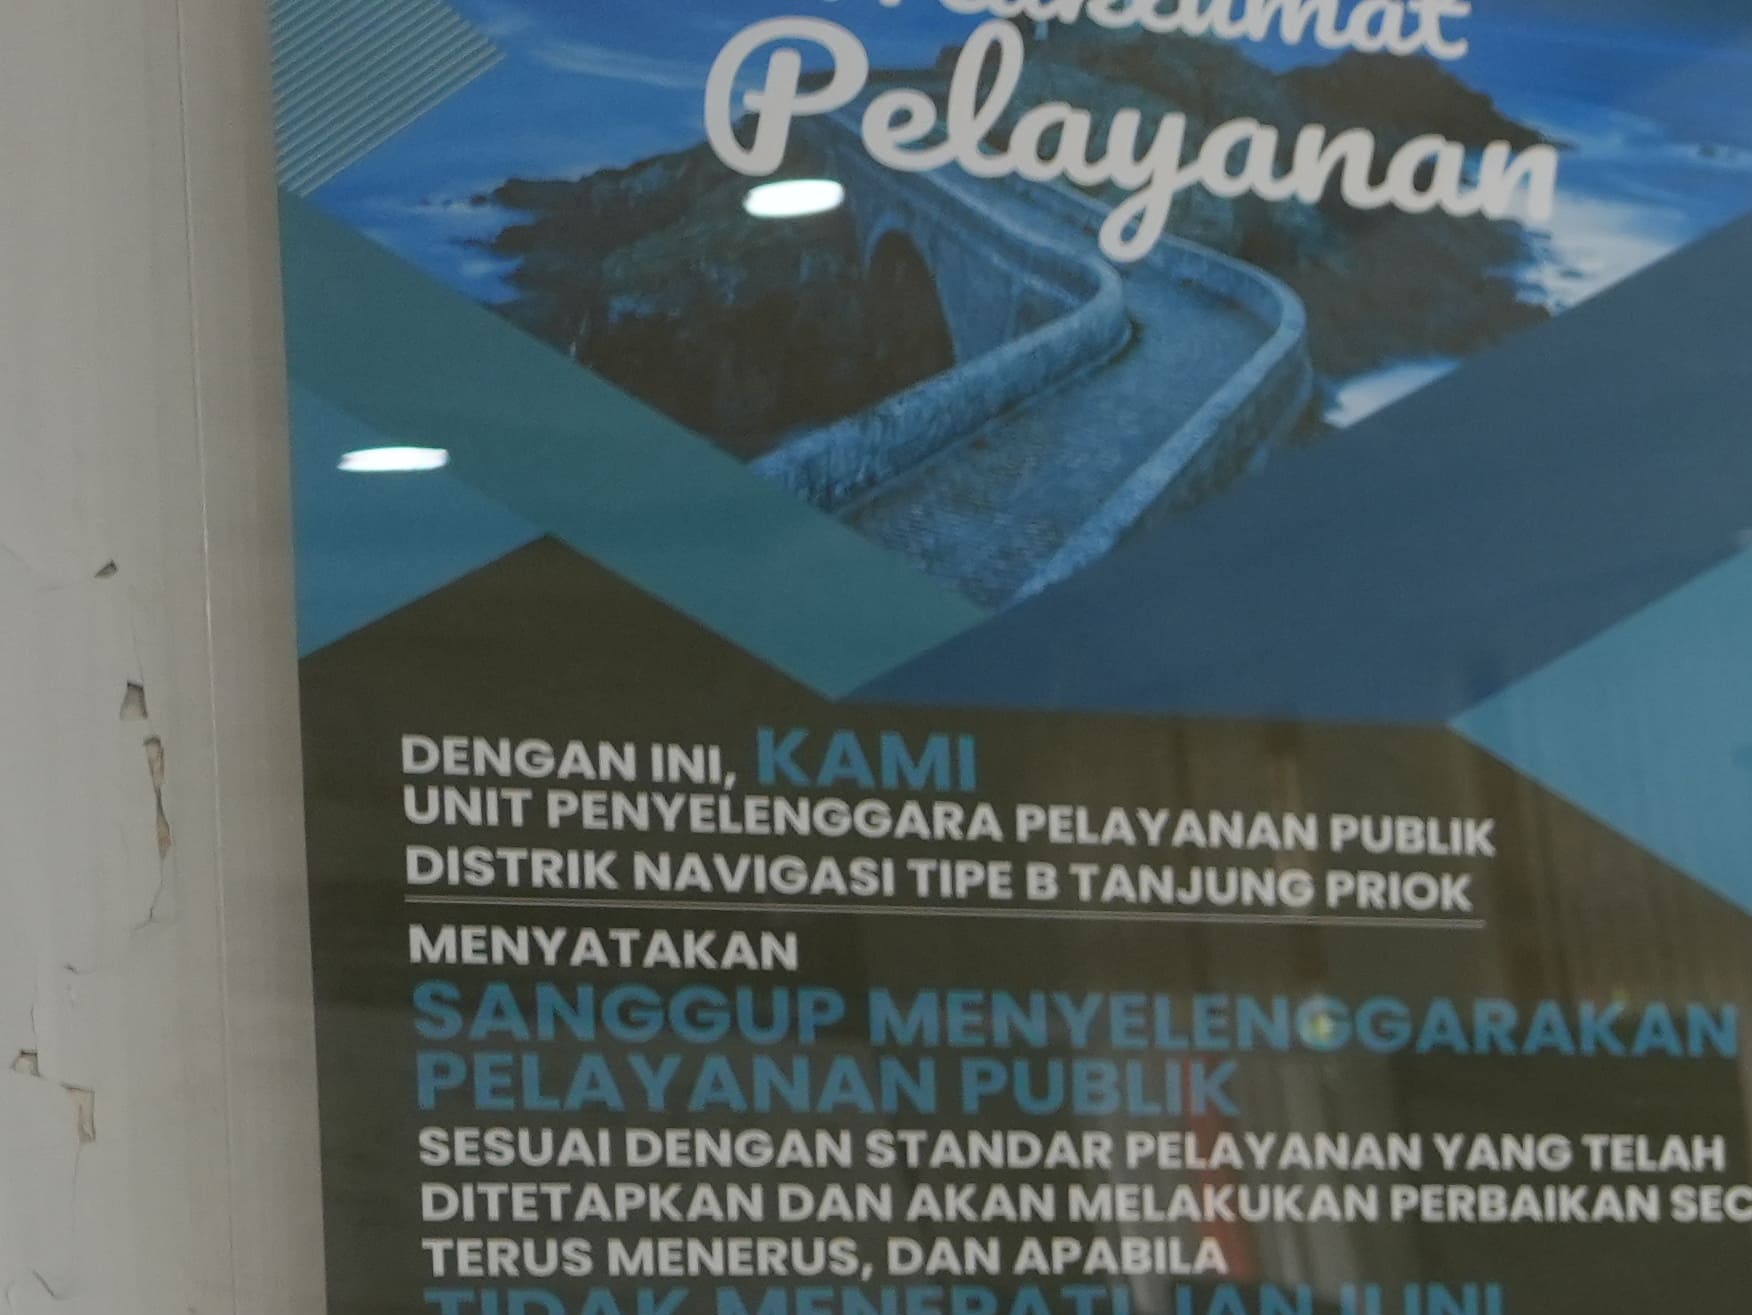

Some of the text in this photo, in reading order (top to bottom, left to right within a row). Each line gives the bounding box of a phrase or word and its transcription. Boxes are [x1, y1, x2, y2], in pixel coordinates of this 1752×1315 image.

[703, 16, 1557, 263] Pelayanan
[402, 730, 976, 790] DENGAN INI, KAMI
[404, 786, 1495, 856] UNIT PENYELENGGARA PELAYANAN PUBLIK
[407, 846, 1472, 910] DISTRIK NAVIGASI TIPE B TANJUNG PRIOK
[409, 925, 797, 970] MENYATAKAN
[414, 982, 1737, 1056] SANGGUP MENYELENGGARAKAN
[418, 1052, 1235, 1115] PELAYANAN PUBLIK
[419, 1128, 1725, 1171] SESUAI DENGAN STANDAR PELAYANAN YANG TELAH
[422, 1183, 763, 1221] DITETAPKAN
[779, 1184, 892, 1221] DAN
[907, 1184, 1055, 1221] AKAN
[1069, 1184, 1378, 1222] MELAKUKAN
[1391, 1185, 1659, 1221] PERBAIKAN
[422, 1236, 1227, 1280] TERUS MENERUS, DAN APABILA
